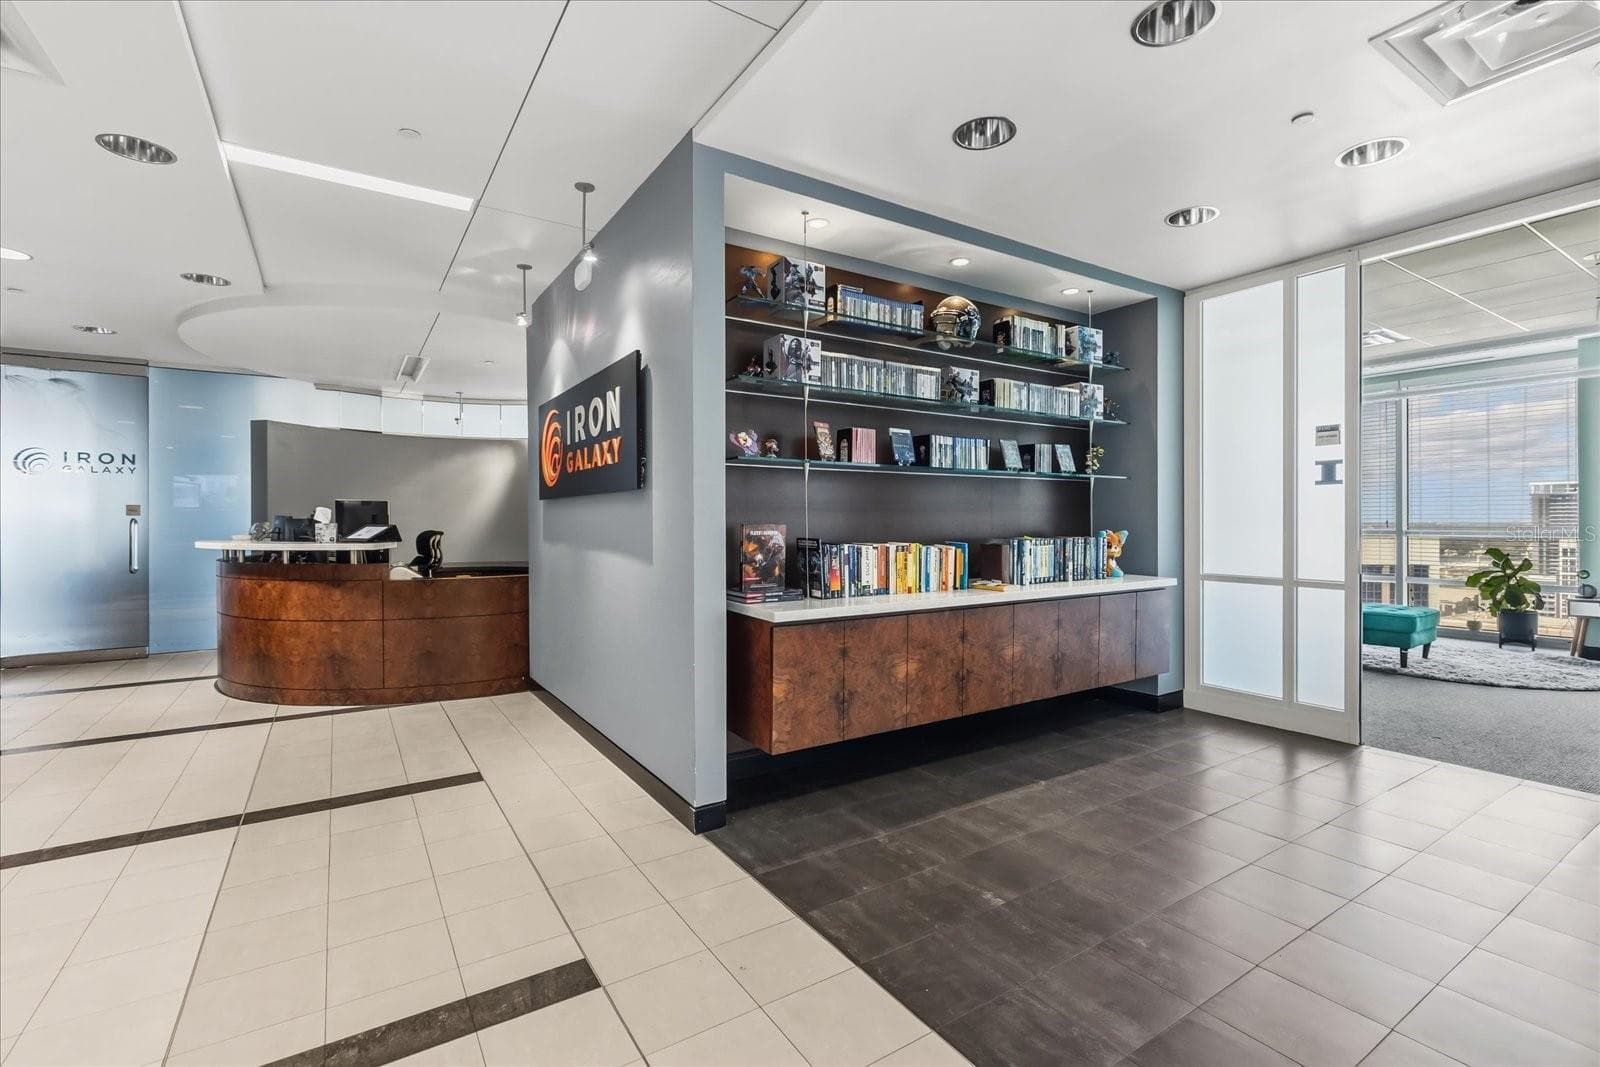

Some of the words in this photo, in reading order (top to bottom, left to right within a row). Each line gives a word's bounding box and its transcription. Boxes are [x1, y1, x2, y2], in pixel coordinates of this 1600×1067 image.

[567, 386, 621, 445] IRON
[63, 451, 136, 465] IRON
[567, 436, 622, 473] GALAXY
